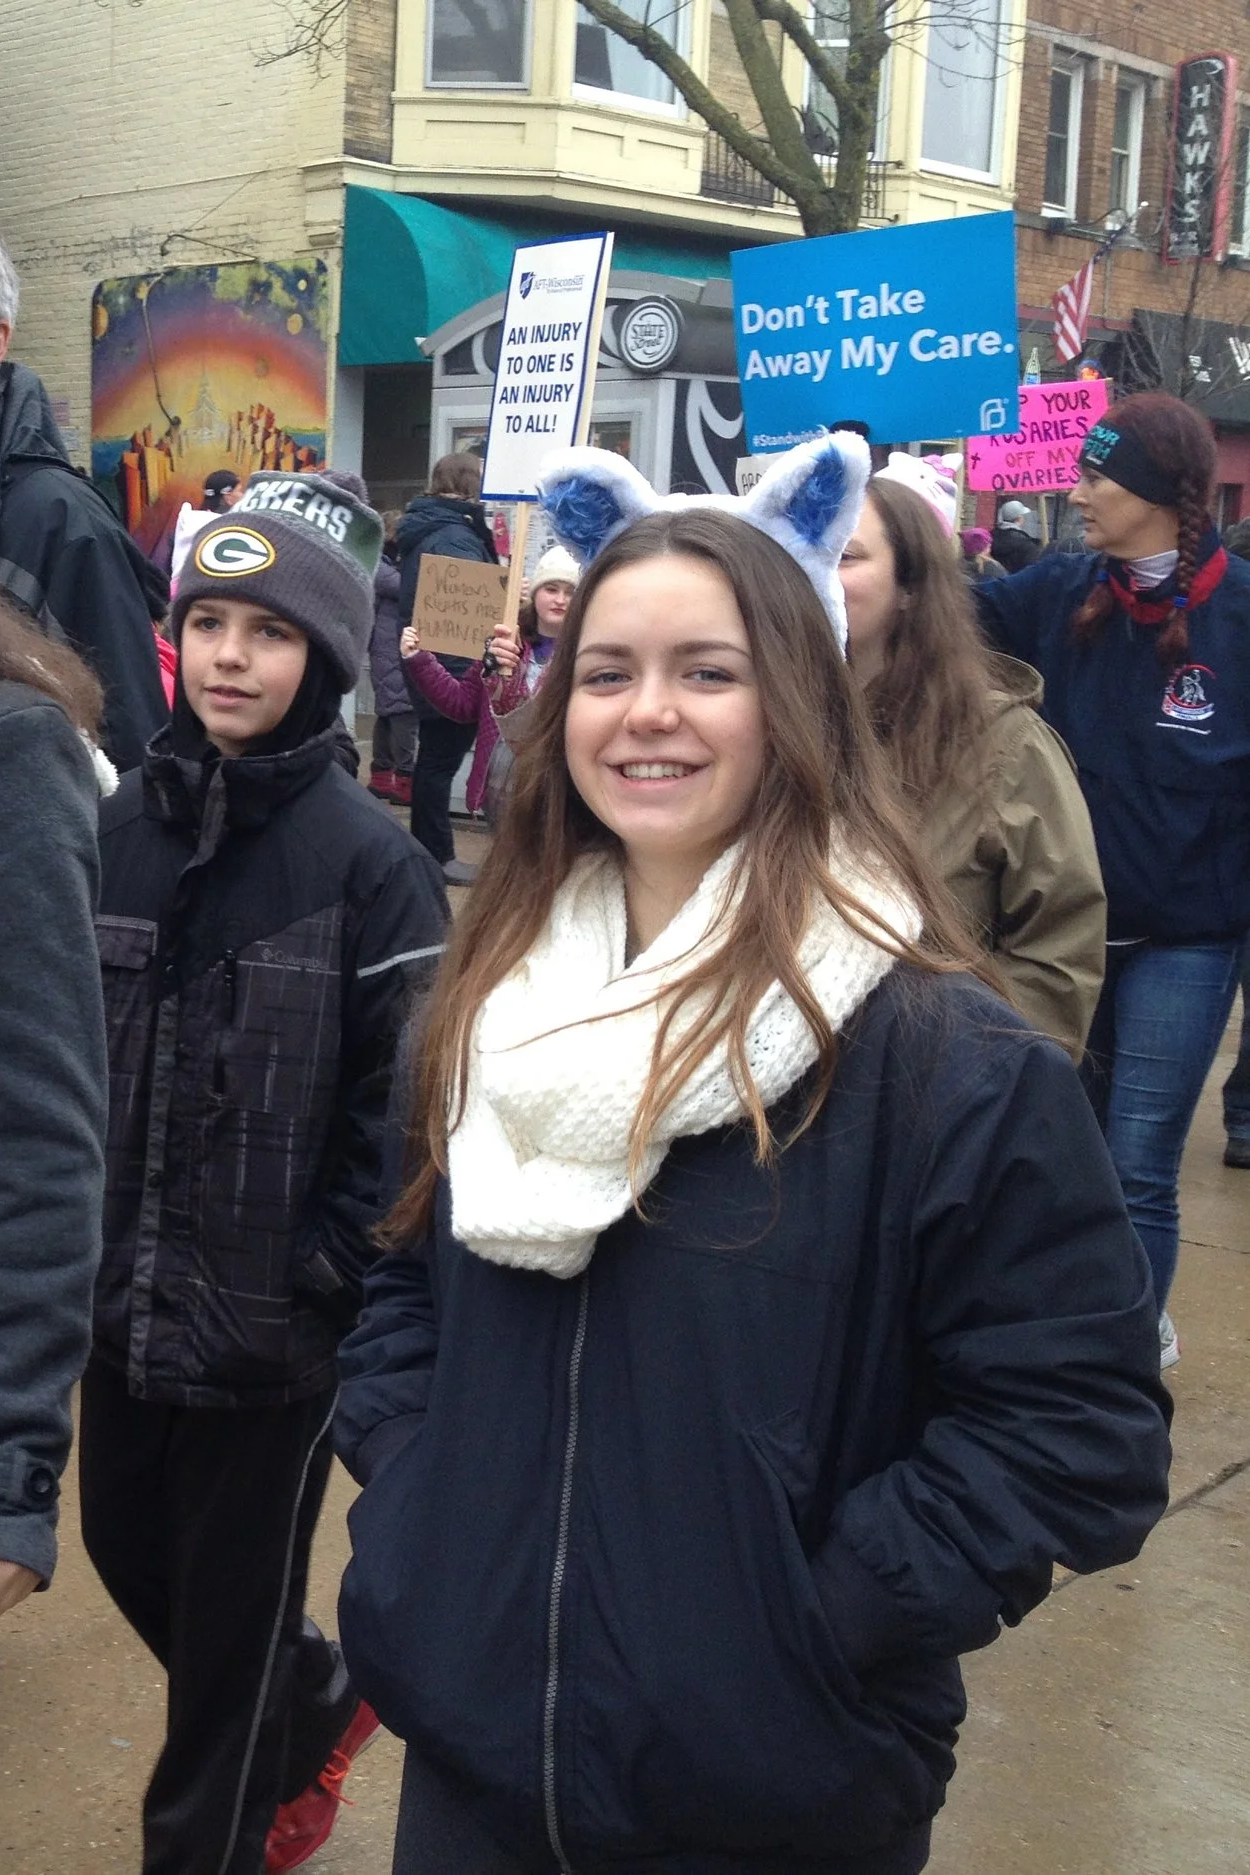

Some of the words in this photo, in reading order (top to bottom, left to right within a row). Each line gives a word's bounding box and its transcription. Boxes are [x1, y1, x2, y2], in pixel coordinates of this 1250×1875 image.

[1180, 84, 1211, 223] HAWKS
[741, 294, 830, 334] Don't
[835, 283, 926, 321] Take
[507, 326, 528, 345] AN
[530, 322, 582, 343] INJURY
[507, 356, 523, 374] TO
[527, 354, 556, 373] ONE
[560, 353, 574, 372] IS
[745, 349, 831, 382] Away
[841, 335, 899, 375] My
[909, 329, 1014, 362] Care.
[499, 386, 519, 404] AN
[522, 384, 574, 403] INJURY
[1041, 389, 1091, 414] YOUR
[506, 415, 523, 433] TO
[525, 414, 557, 432] ALL!
[1006, 451, 1035, 468] OFF
[1047, 445, 1080, 464] MY
[992, 465, 1080, 490] OVARIES
